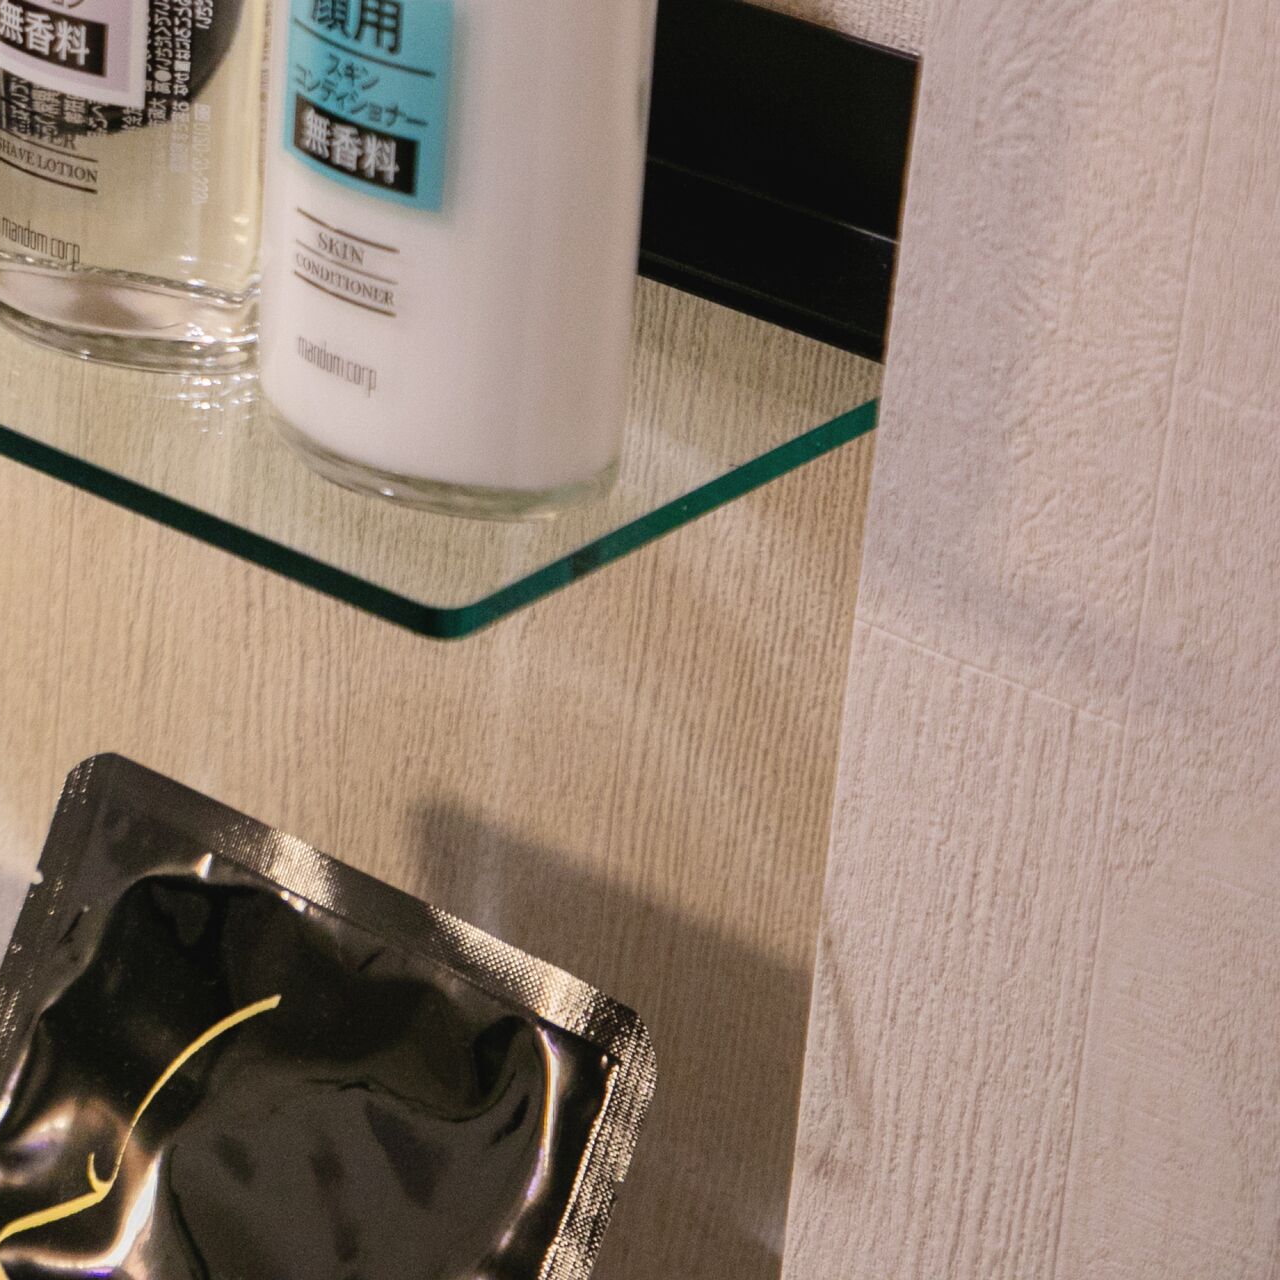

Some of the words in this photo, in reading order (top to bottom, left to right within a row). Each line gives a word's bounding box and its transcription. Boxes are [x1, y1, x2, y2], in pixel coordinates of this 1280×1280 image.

[293, 63, 429, 127] コンディショナー
[327, 53, 380, 91] スキン
[36, 154, 99, 183] LOTION
[304, 108, 401, 184] 無香料
[1, 216, 48, 255] mandom
[50, 237, 81, 271] corp
[317, 231, 365, 266] SKIN
[295, 252, 395, 306] CONDITIONER
[297, 334, 345, 379] mandom
[346, 360, 378, 399] corp
